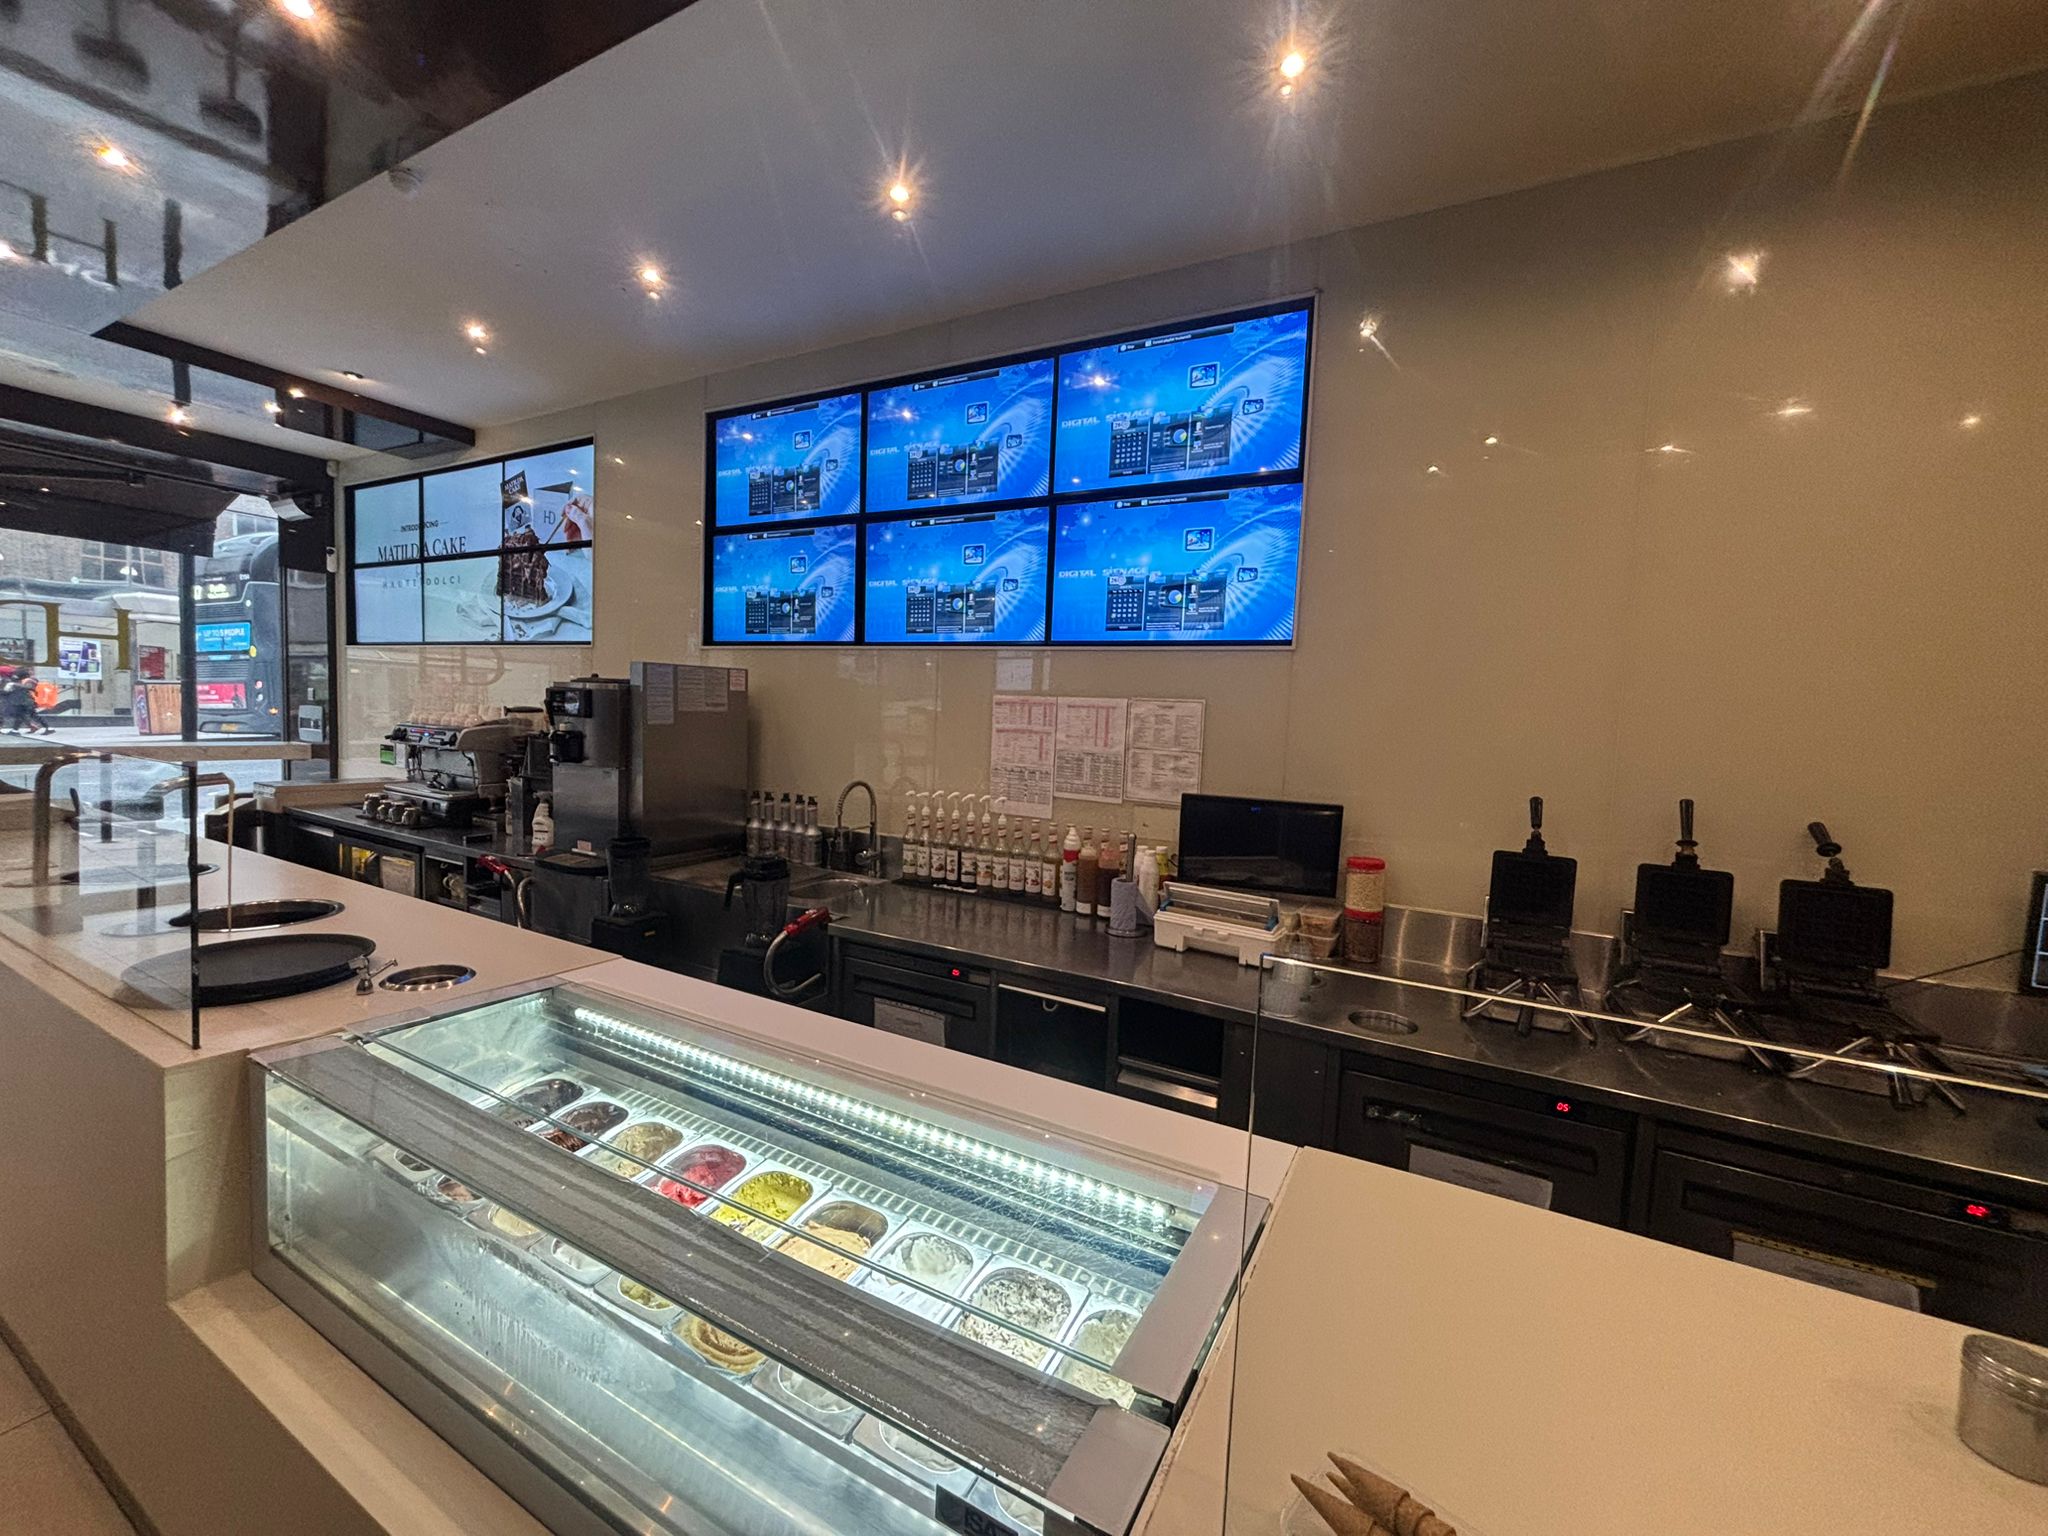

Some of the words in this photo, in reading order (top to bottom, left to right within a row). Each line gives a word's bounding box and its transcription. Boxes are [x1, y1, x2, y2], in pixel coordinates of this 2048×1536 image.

[1061, 416, 1101, 429] DIGITAL
[543, 510, 556, 525] HD
[377, 540, 430, 562] MATILDA
[432, 535, 467, 557] CAKE
[1058, 568, 1097, 579] DIGITAL
[426, 575, 461, 587] DOLCI
